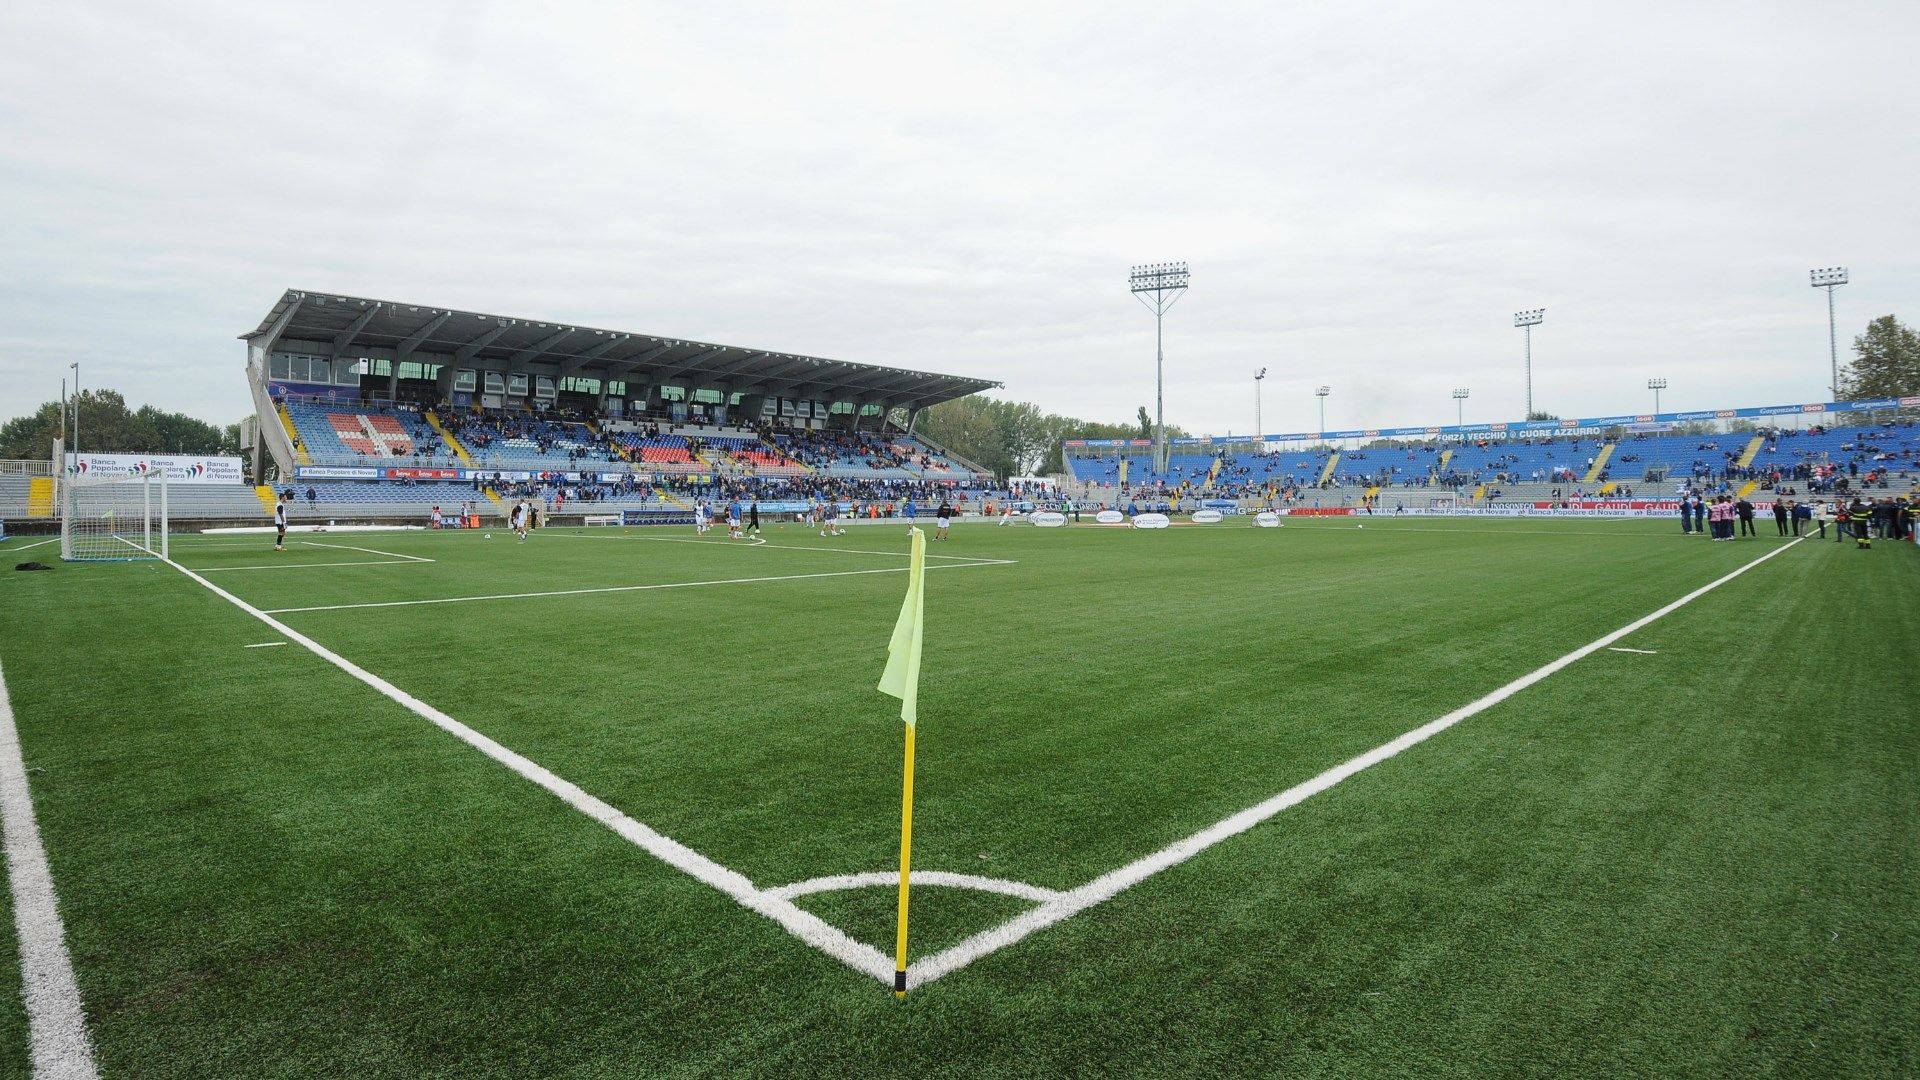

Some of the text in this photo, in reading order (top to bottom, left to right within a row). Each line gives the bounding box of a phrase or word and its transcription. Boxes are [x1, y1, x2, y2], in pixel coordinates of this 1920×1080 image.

[1851, 399, 1897, 409] Gorgonzola
[1760, 406, 1800, 415] Gorgonzola
[1676, 412, 1714, 420] Gorgonzola
[1526, 421, 1559, 429] Gorgonzola
[1599, 417, 1634, 425] Gorgonzola
[1437, 427, 1601, 442] FORZA VECCHIO CUORE AZZURRO
[91, 465, 127, 473] Popolare
